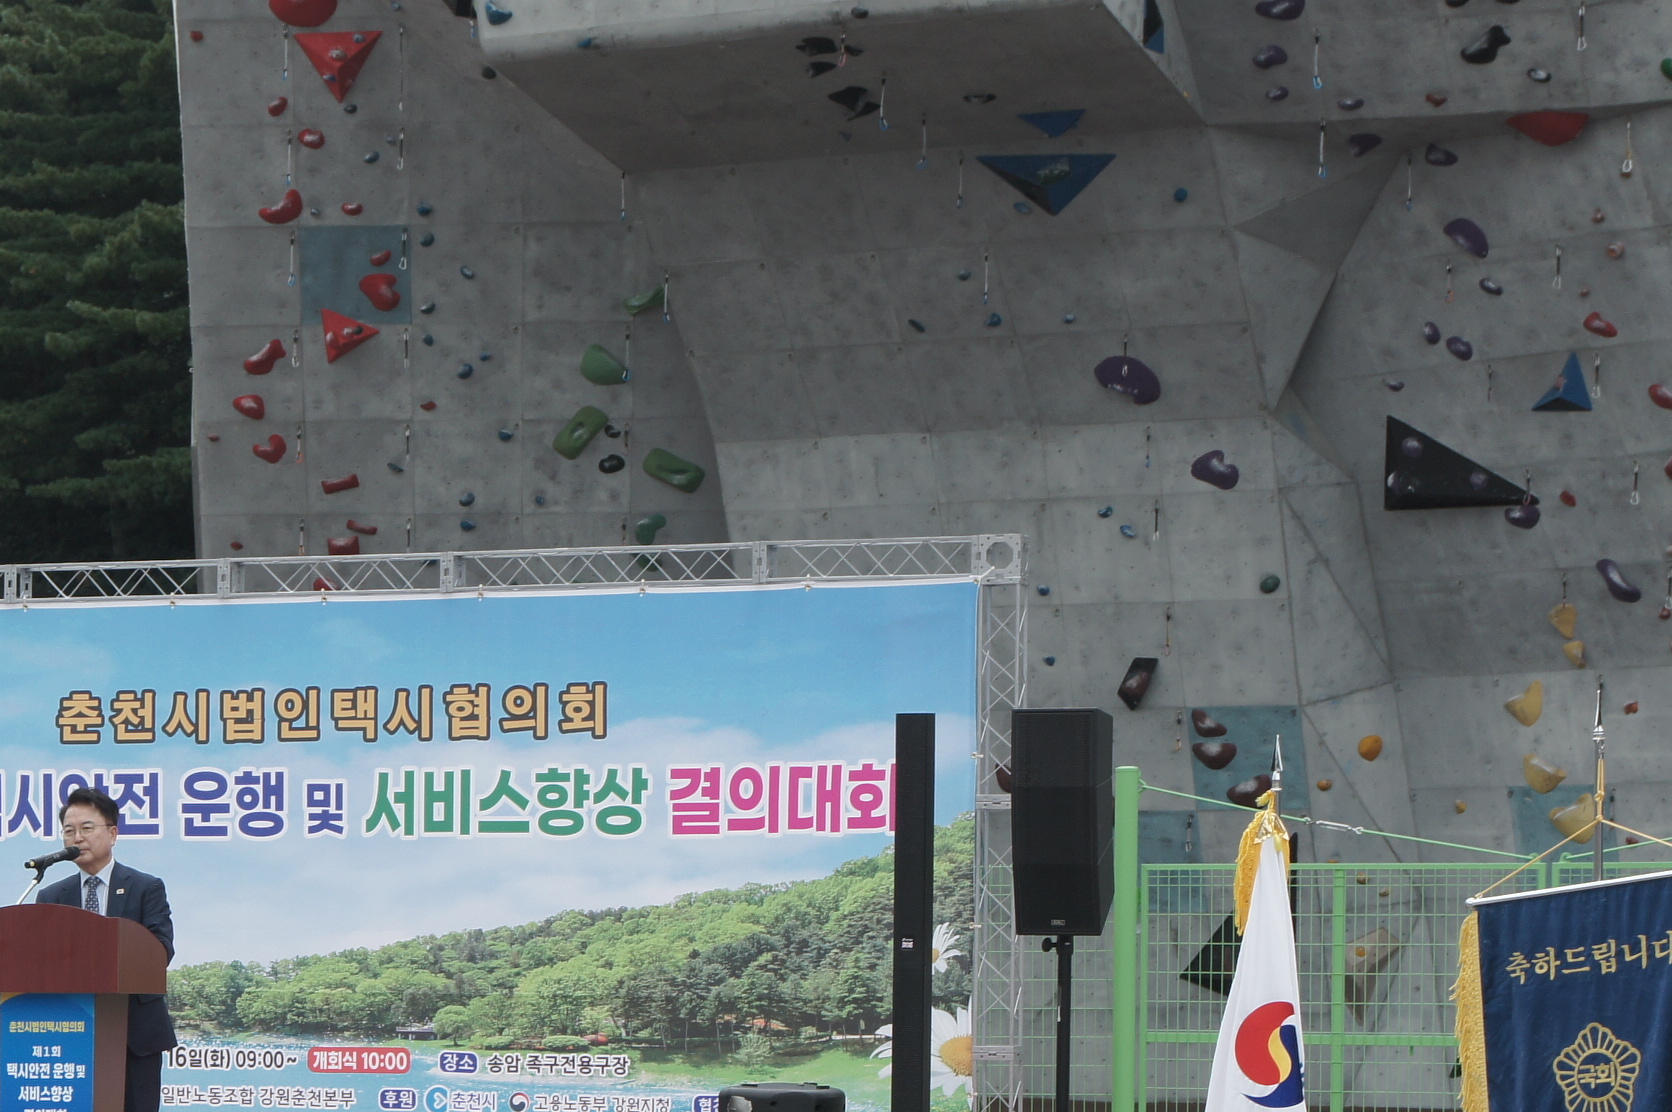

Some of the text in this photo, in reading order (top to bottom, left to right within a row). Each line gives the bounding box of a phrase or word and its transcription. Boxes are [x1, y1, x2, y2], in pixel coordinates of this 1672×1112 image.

[56, 681, 608, 744] 춘천시법인택시협의회
[182, 769, 287, 838] 운행
[305, 780, 345, 835] 및
[364, 766, 649, 837] 서비스향상
[668, 762, 897, 835] 결의대회
[1505, 930, 1672, 985] 축하드립니다
[9, 1021, 86, 1033] 춘천시법인택시협의회
[6, 1062, 86, 1080] 택시안전 운행 및
[167, 1046, 630, 1077] 16일(화) 09:00~ 개회식 10:00 장소 송암 족구전용구장
[1577, 1062, 1618, 1091] 국회
[17, 1085, 74, 1103] 서비스향상
[161, 1086, 255, 1106] 일반노동조합
[259, 1087, 356, 1109] 강원춘천본부
[383, 1090, 415, 1109] 후원
[451, 1092, 497, 1112] 춘천시
